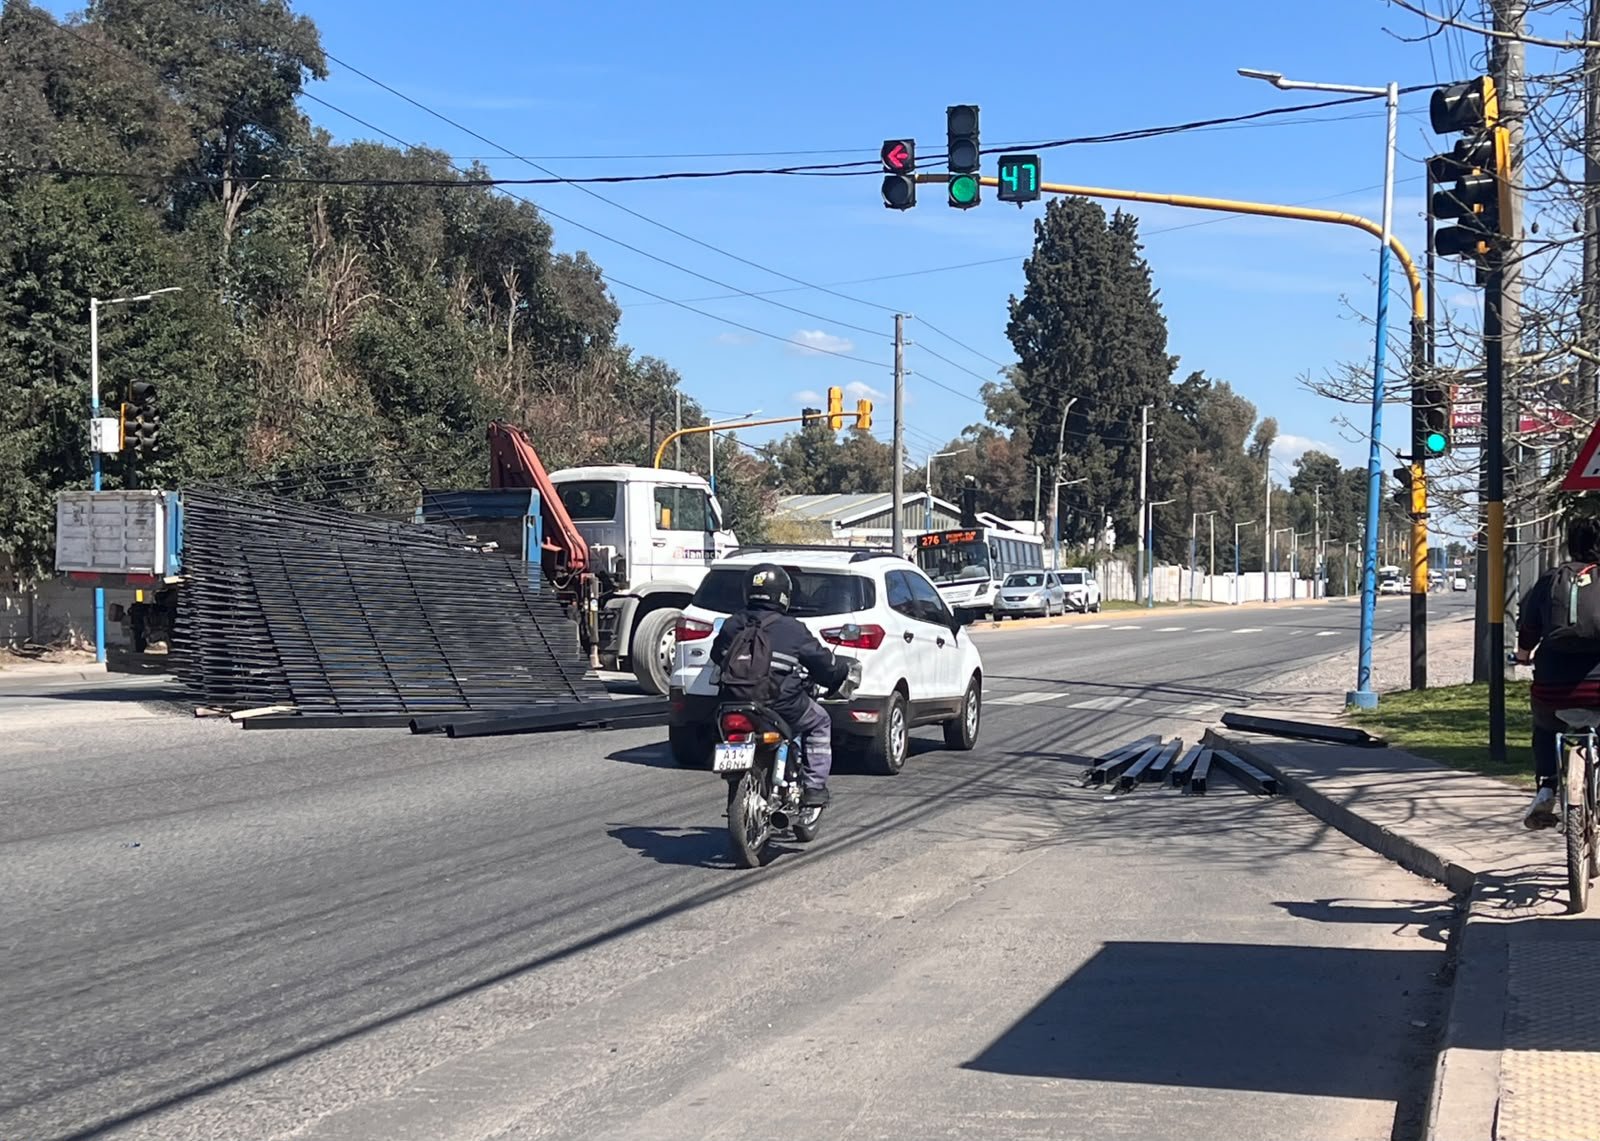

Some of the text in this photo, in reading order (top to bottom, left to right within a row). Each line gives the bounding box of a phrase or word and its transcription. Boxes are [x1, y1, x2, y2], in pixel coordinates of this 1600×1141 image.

[1002, 164, 1036, 191] 47
[921, 535, 940, 547] 276
[723, 749, 745, 760] A14
